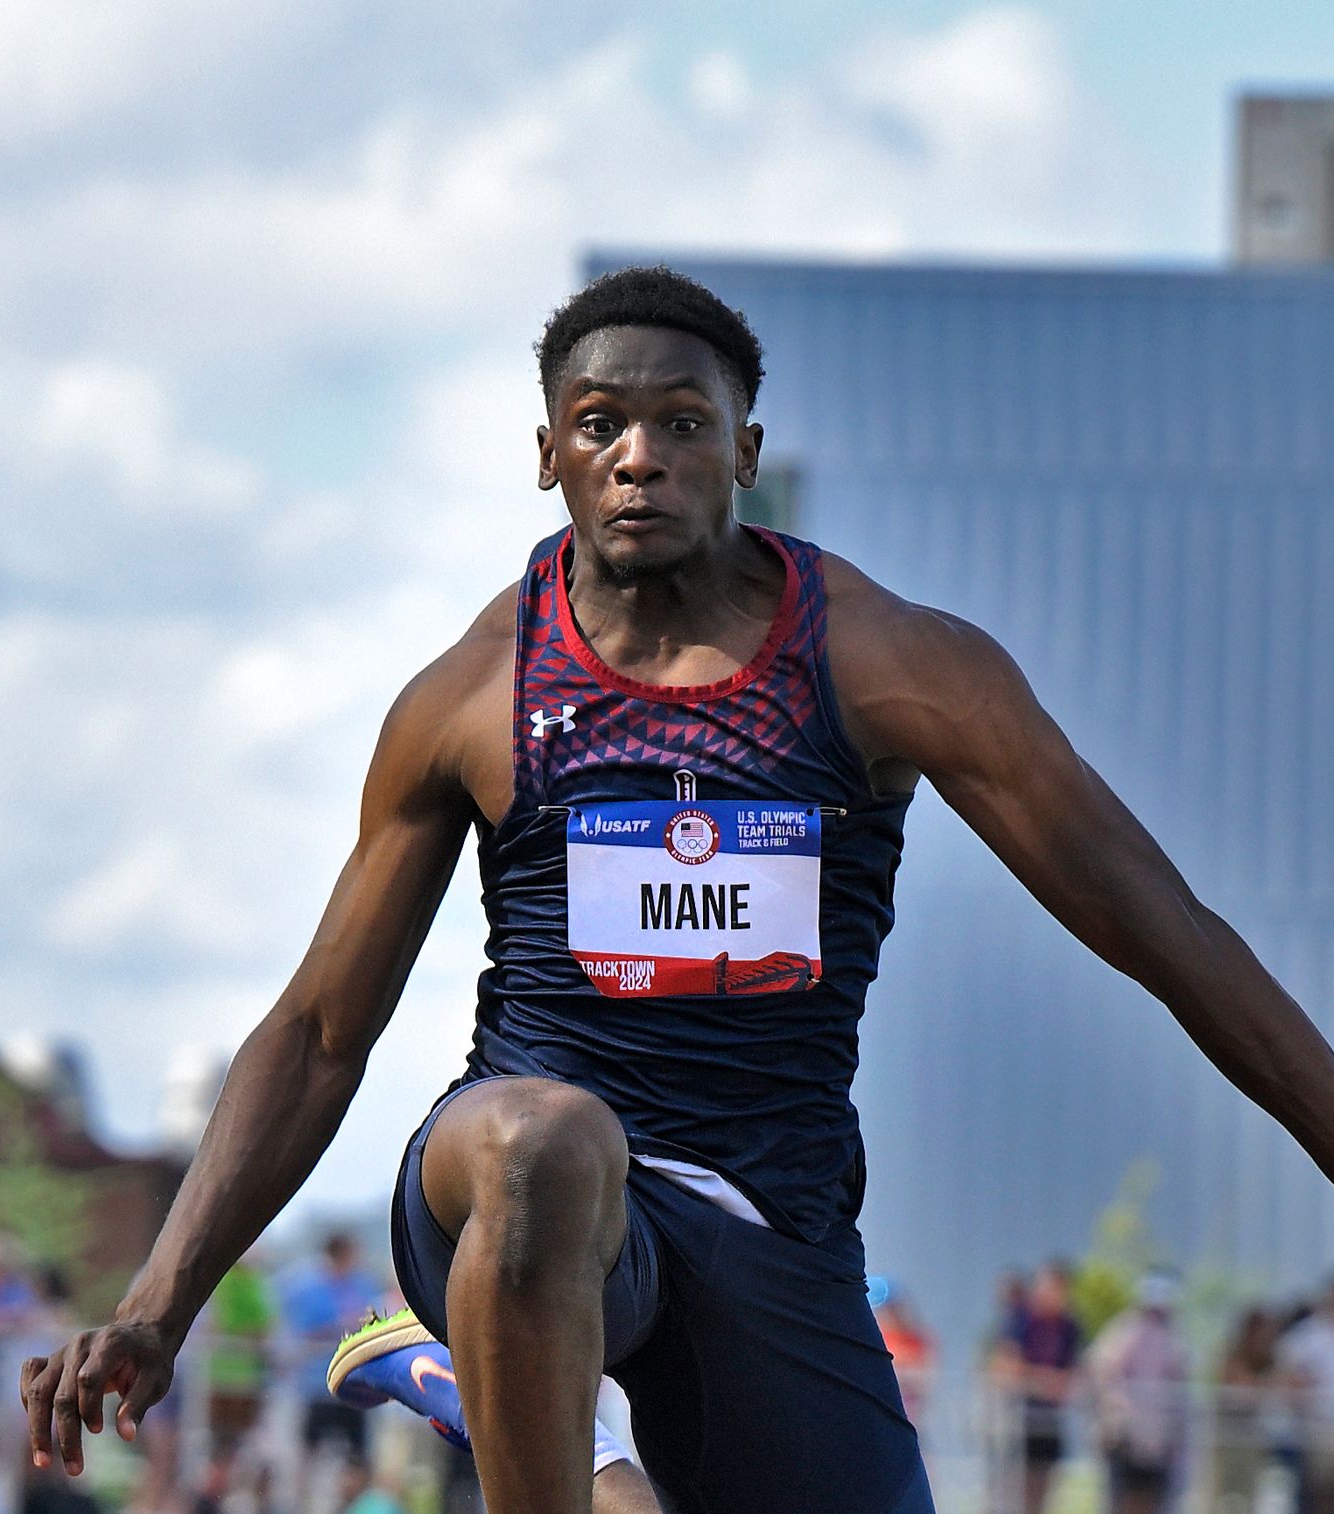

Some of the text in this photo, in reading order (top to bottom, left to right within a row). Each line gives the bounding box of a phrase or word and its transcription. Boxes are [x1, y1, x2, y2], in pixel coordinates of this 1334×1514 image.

[737, 811, 806, 824] U.S. OLYMPIC
[602, 820, 651, 833] USATF
[737, 825, 806, 838] TEAM TRIALS
[739, 838, 789, 848] TRACK & FIELD
[640, 883, 751, 930] MANE
[579, 960, 655, 977] TRACKTOWN
[619, 974, 651, 991] 2024
